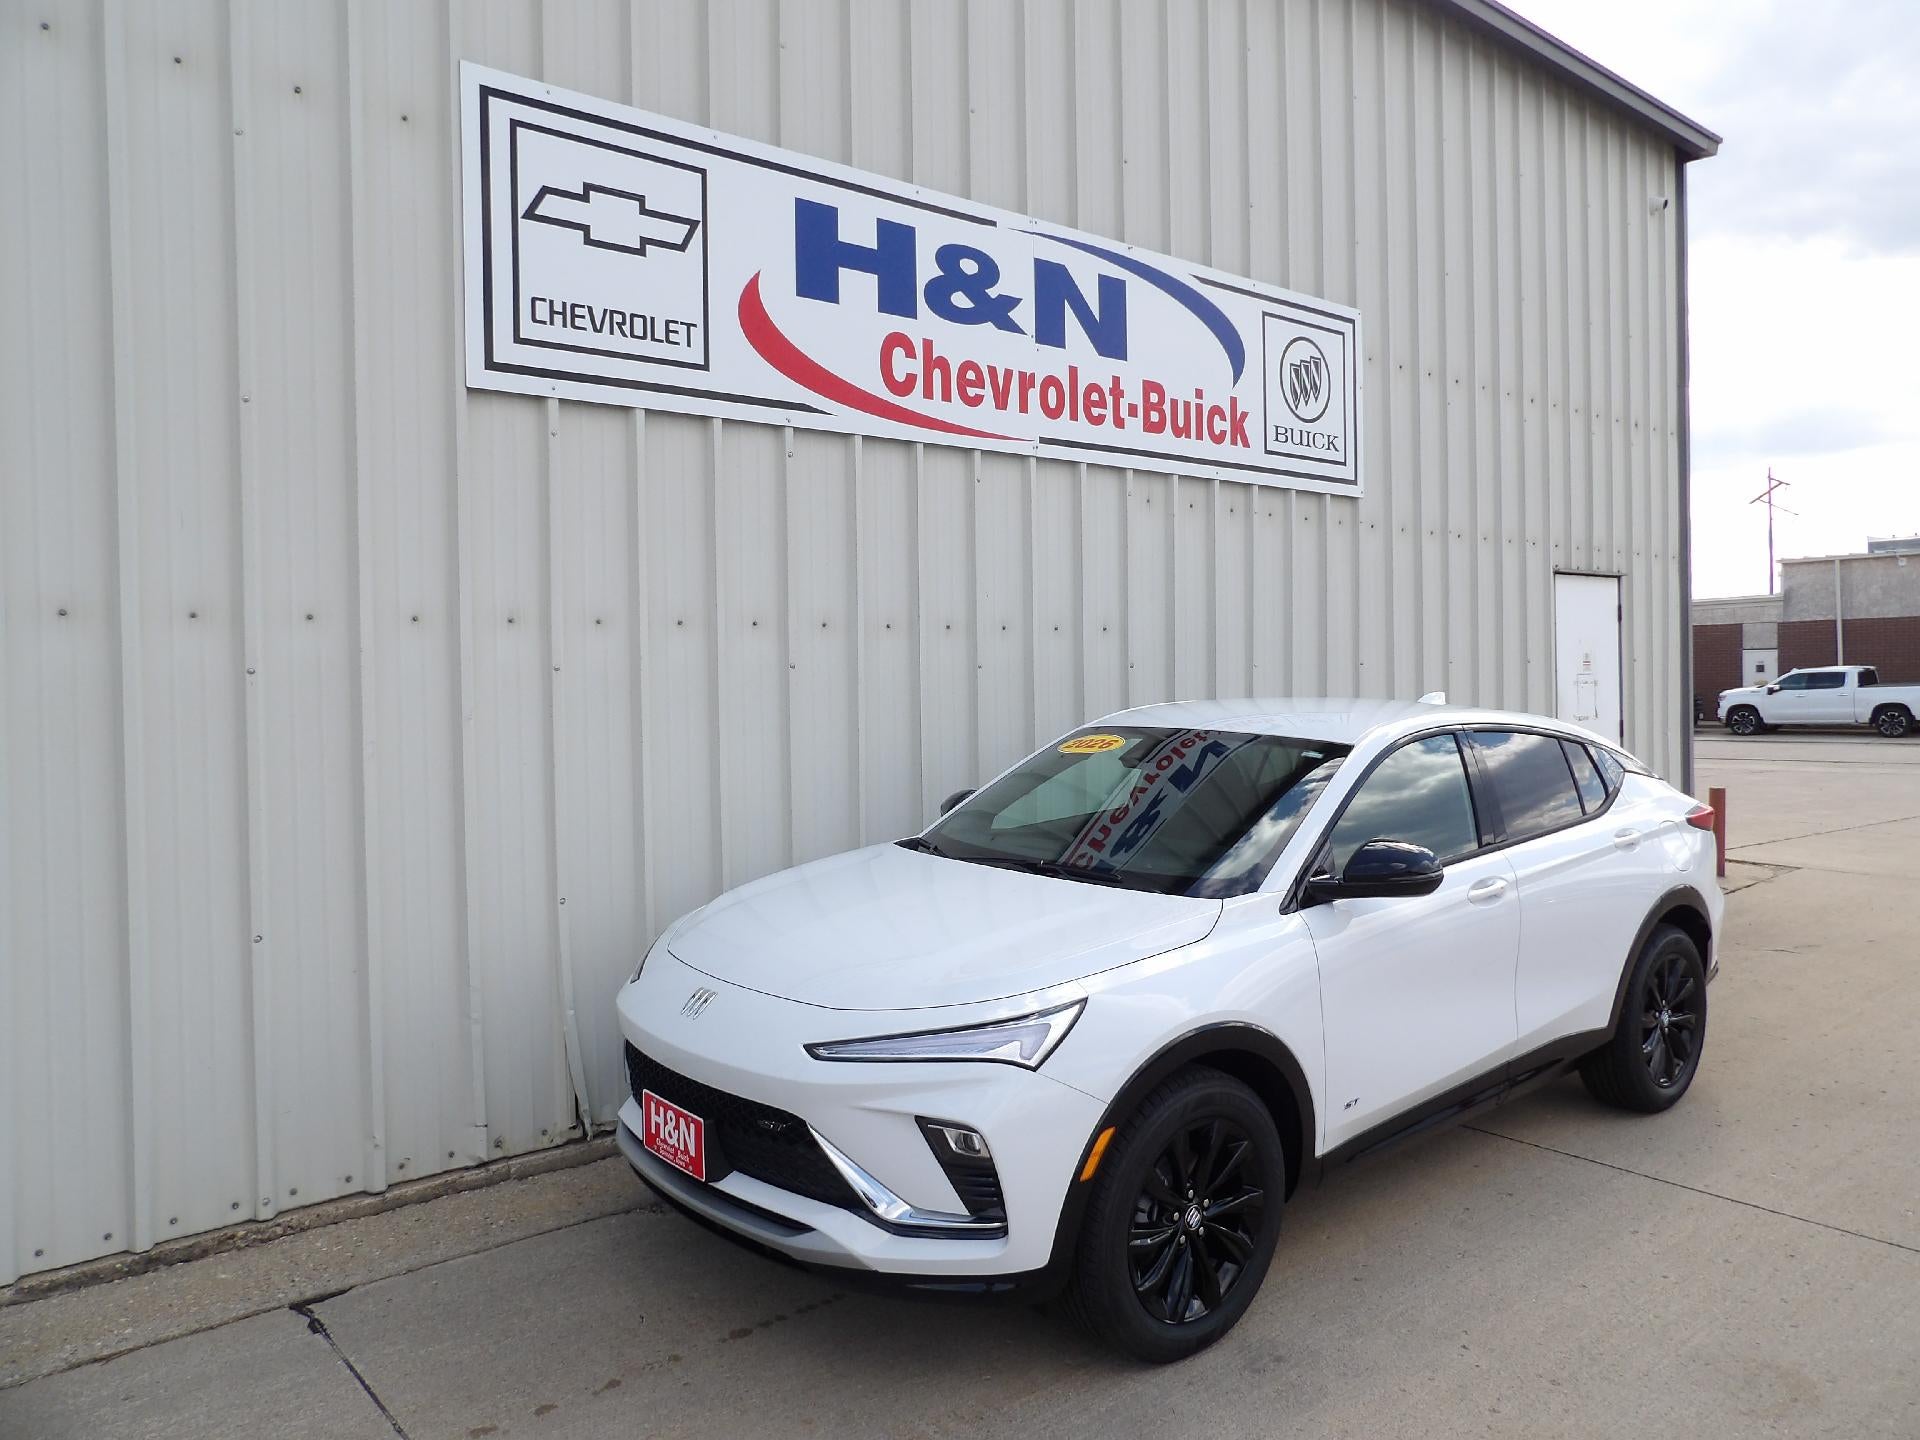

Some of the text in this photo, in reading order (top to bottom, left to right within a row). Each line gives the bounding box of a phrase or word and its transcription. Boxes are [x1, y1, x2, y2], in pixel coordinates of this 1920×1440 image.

[795, 197, 1127, 361] H&N
[530, 296, 698, 349] CHEVROLET
[879, 331, 1251, 449] Chevrolet-Buick
[1273, 424, 1341, 453] BUICK
[1063, 738, 1119, 749] 2026
[650, 1101, 696, 1158] H&N
